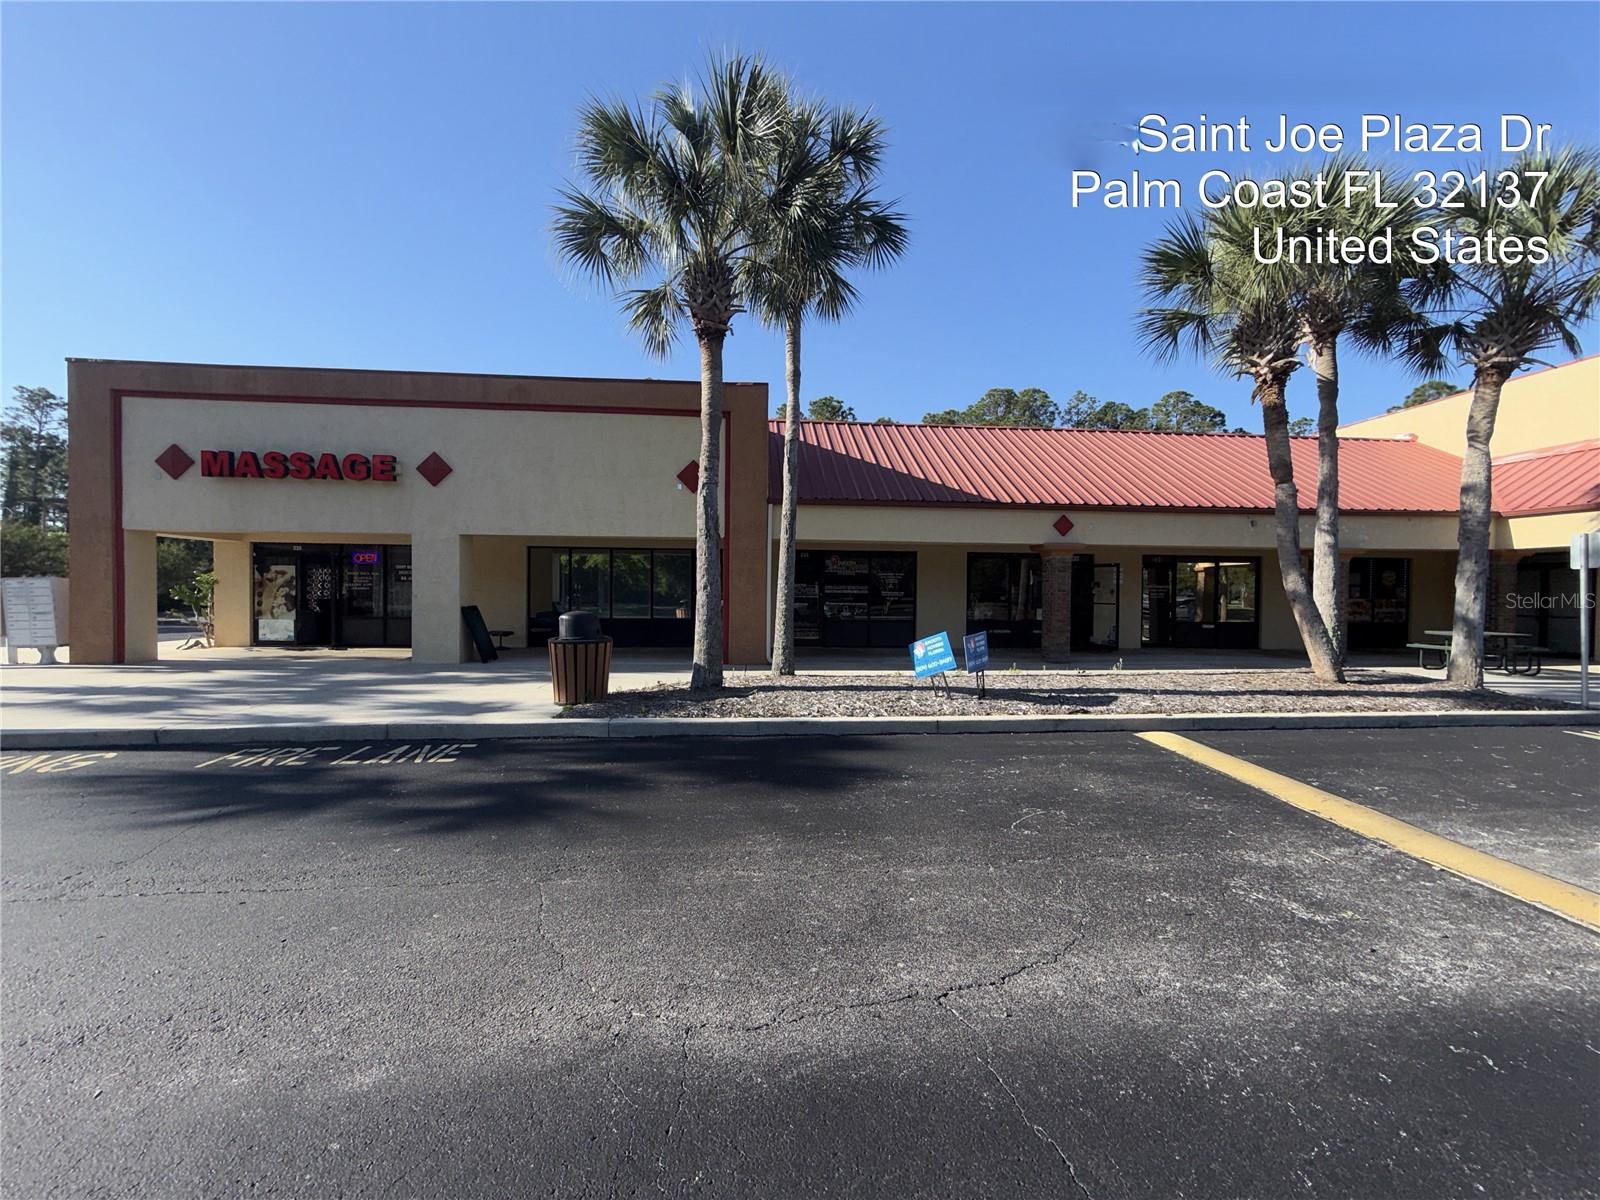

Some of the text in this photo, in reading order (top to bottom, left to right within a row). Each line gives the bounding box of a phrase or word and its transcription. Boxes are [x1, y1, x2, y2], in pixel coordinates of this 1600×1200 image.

[200, 451, 397, 481] MASSAGE
[353, 553, 377, 563] OPEN
[195, 745, 478, 767] FIRE LANE
